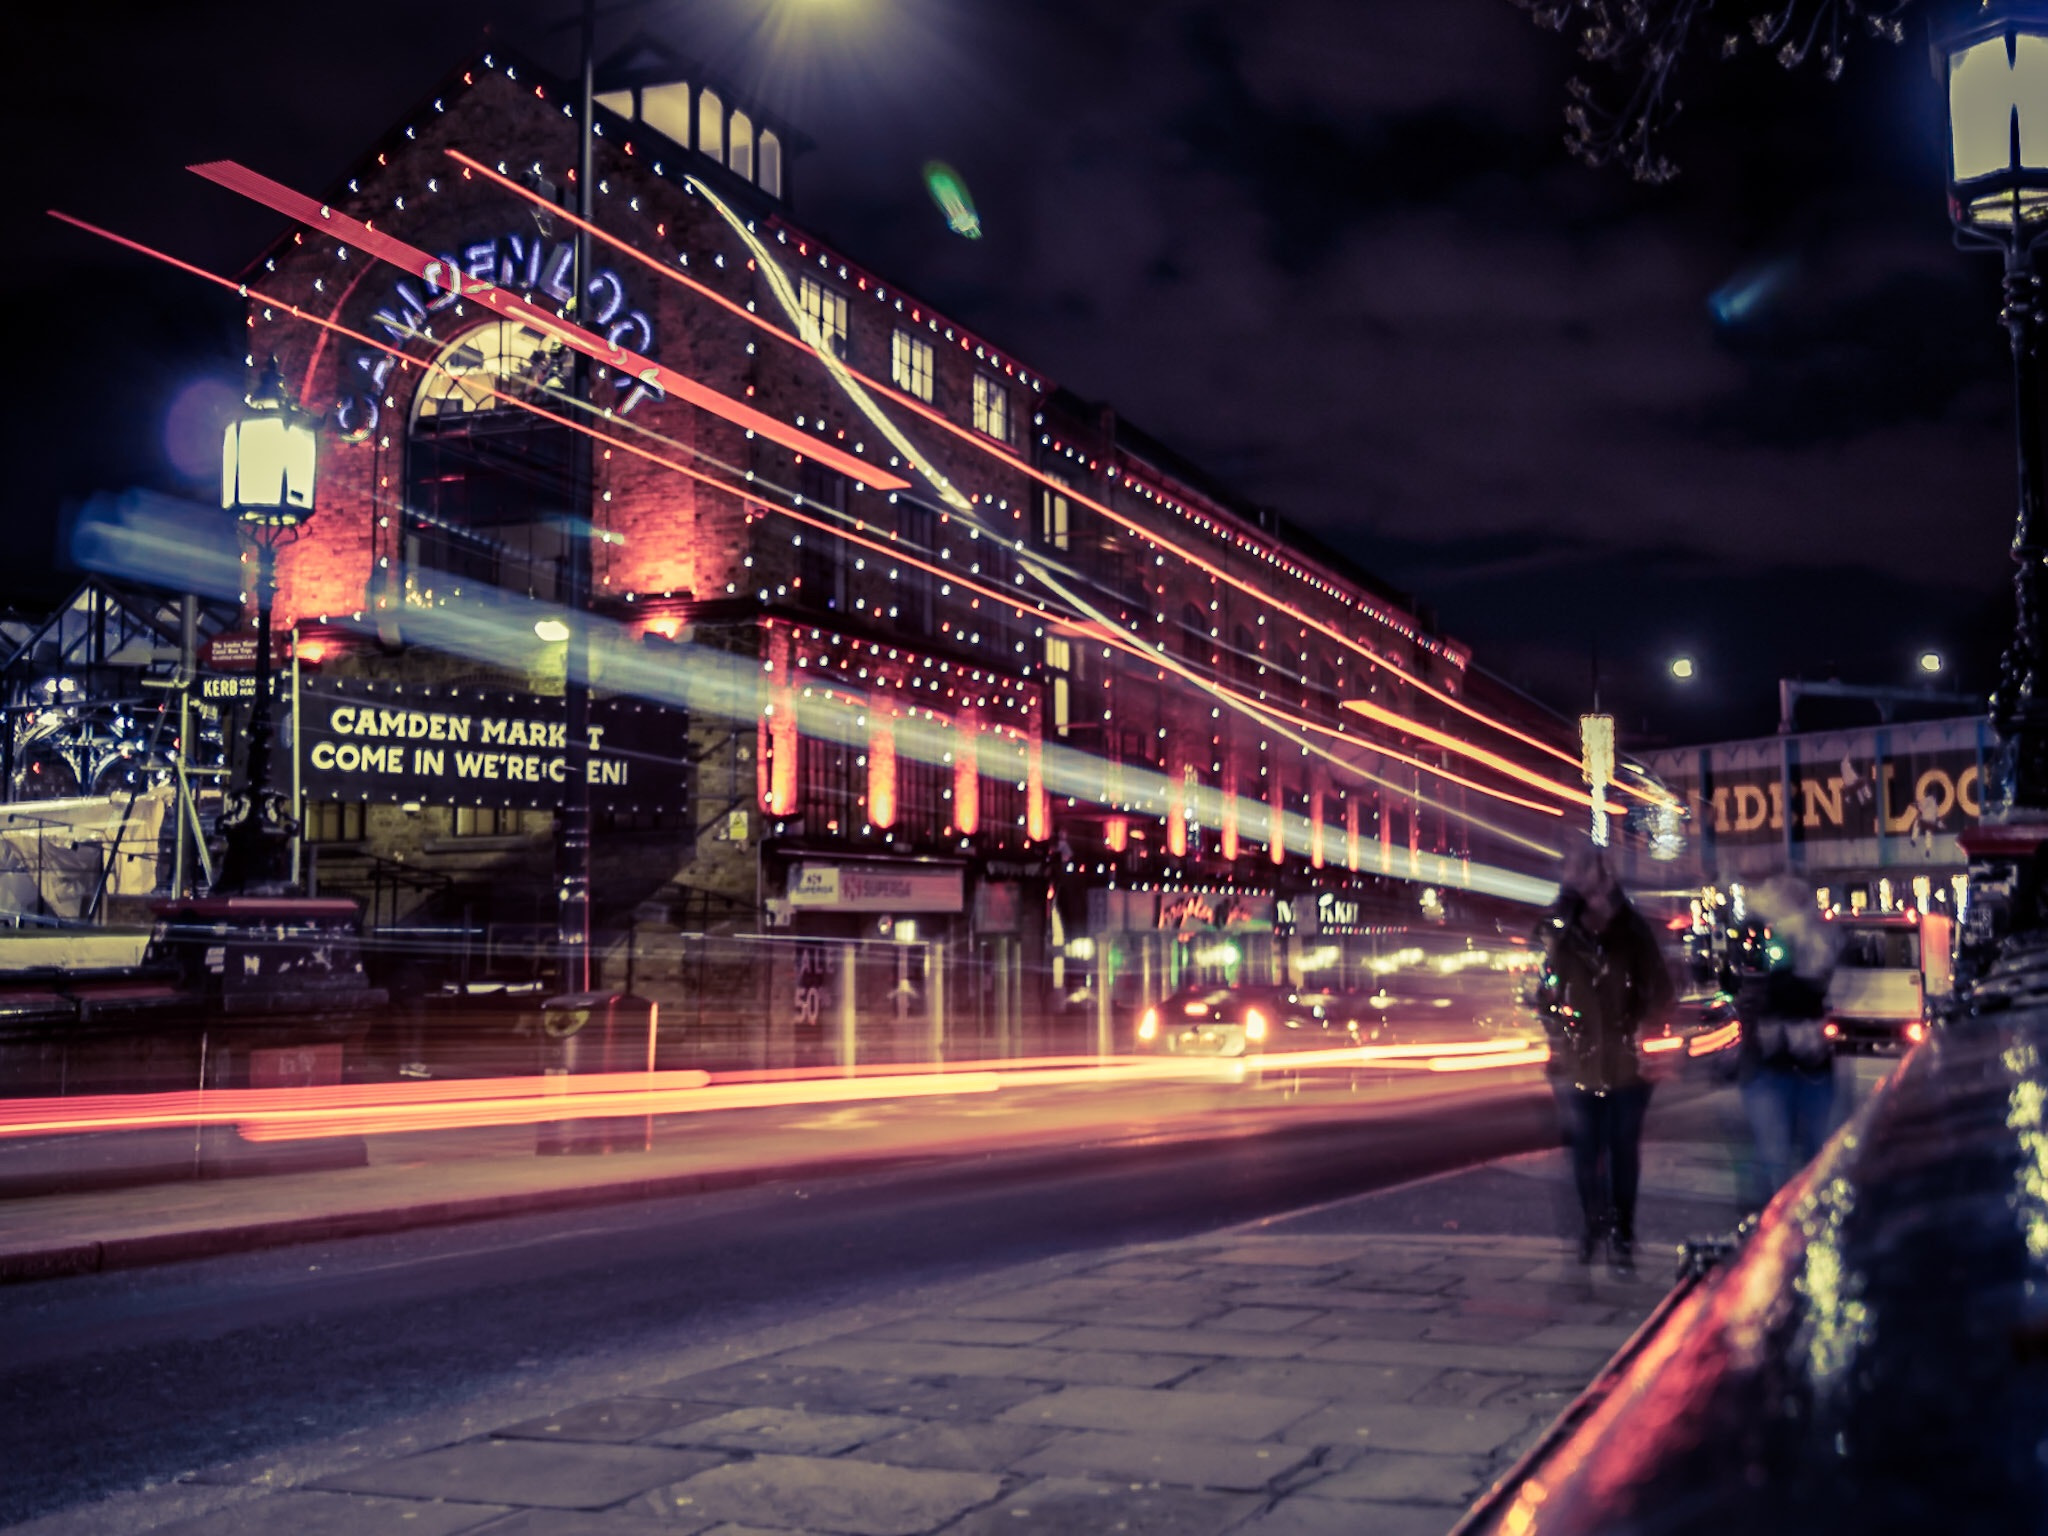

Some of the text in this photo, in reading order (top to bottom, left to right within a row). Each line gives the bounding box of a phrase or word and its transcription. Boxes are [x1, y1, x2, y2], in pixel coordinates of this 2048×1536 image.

[336, 237, 542, 442] CAMDEN
[203, 679, 239, 698] KERB
[331, 706, 605, 751] CAMDEN MARKT
[311, 741, 629, 786] COME IN WE'RE OEN!
[1687, 764, 1989, 835] MDEN LOC
